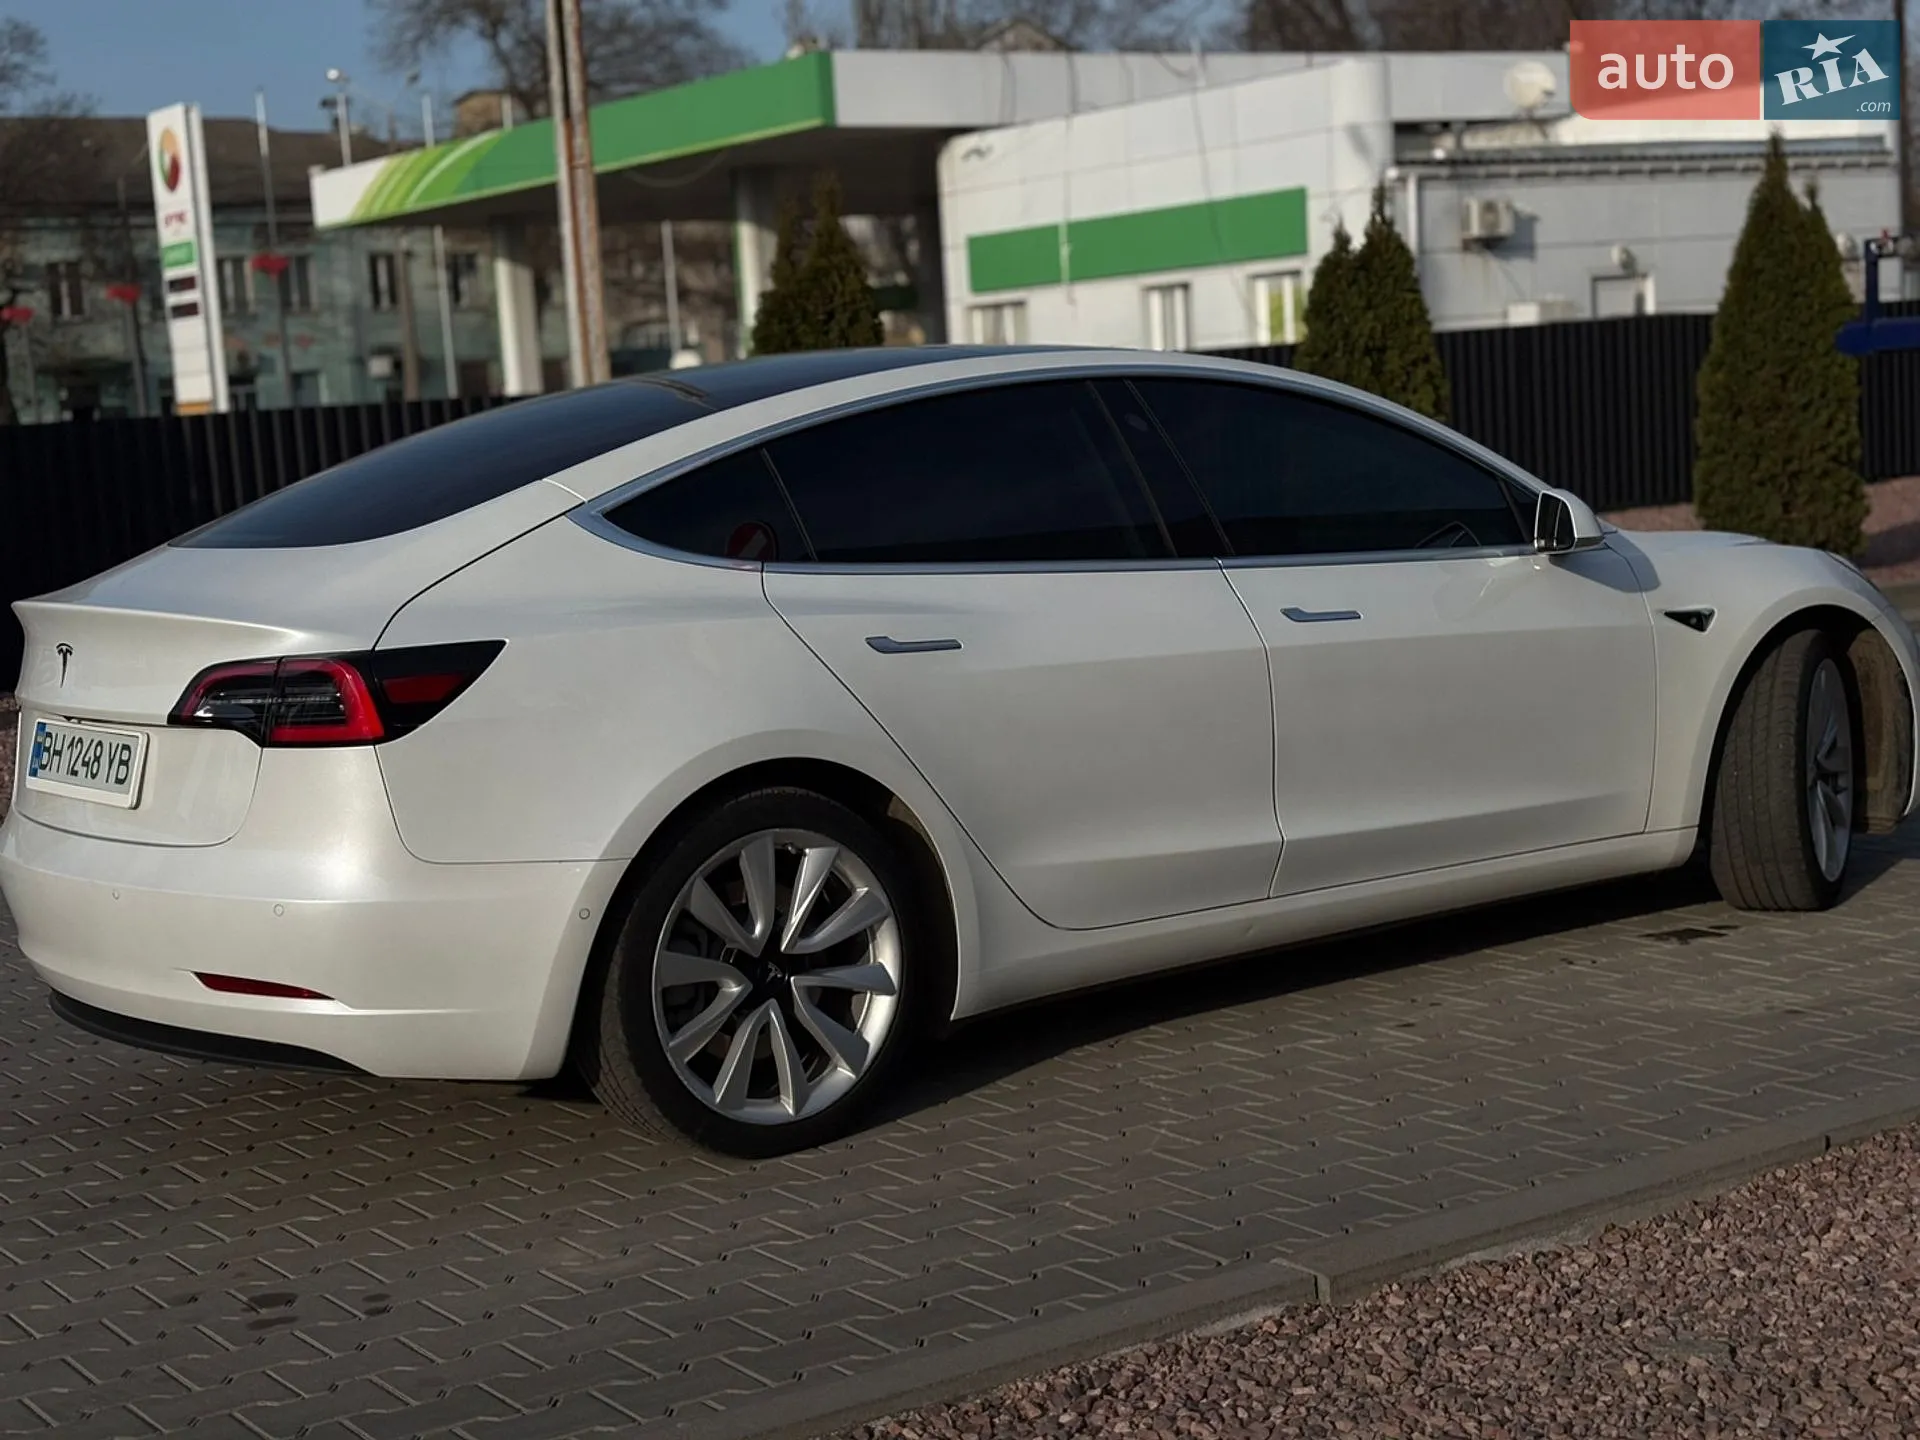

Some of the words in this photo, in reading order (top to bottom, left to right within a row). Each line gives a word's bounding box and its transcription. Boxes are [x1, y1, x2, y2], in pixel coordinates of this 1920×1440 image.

[39, 731, 66, 774] BH
[66, 735, 103, 780] 1248
[105, 741, 132, 785] YB
